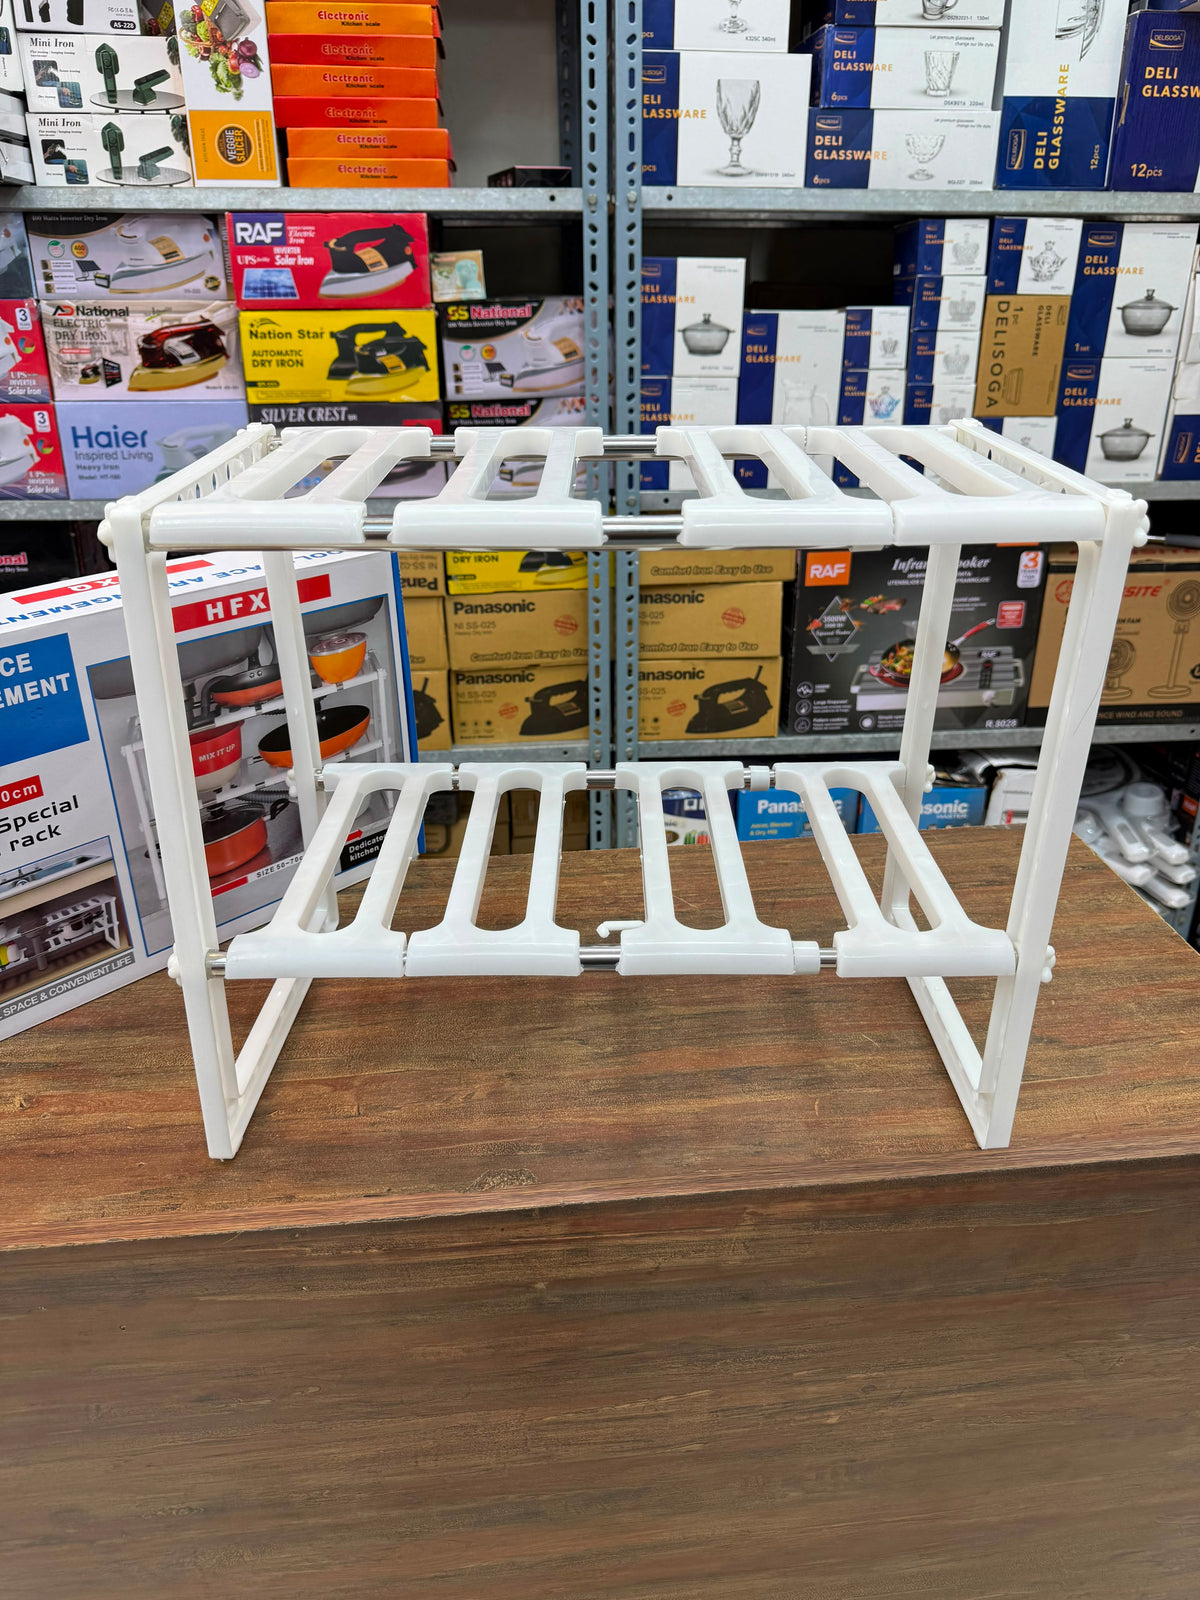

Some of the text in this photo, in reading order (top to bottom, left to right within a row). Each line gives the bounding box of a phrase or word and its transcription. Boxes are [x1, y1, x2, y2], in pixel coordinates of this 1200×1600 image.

[318, 10, 369, 21] Electronic
[30, 38, 74, 48] Mini Iron
[321, 44, 373, 55] Electronic
[834, 50, 856, 60] DELI
[833, 62, 893, 72] GLASSWARE
[1145, 67, 1178, 79] DELI
[322, 73, 373, 83] Electronic
[1142, 85, 1200, 98] GLASSW
[643, 95, 661, 104] ELI
[325, 108, 376, 118] Electronic
[643, 109, 707, 119] LASSWARE
[1048, 64, 1070, 170] GLASSWARE
[38, 118, 81, 127] Mini Iron
[226, 129, 236, 161] VEGGIE
[336, 134, 387, 144] Electronic
[815, 136, 842, 146] DELI
[236, 130, 246, 162] SLICER
[1033, 131, 1048, 169] DELI
[814, 151, 888, 161] GLASSWARE
[1090, 144, 1100, 170] 12pcs
[337, 164, 387, 174] Electronic
[642, 164, 656, 173] pcs
[1130, 163, 1162, 177] 12pcs
[235, 222, 283, 244] RAF
[237, 255, 256, 265] UPS
[275, 255, 296, 265] Solar
[297, 255, 314, 265] Iron
[1085, 255, 1108, 264] DELI
[1084, 267, 1144, 275] GLASSWARE
[19, 309, 28, 321] 3
[76, 305, 129, 317] National
[470, 304, 532, 319] National
[1044, 306, 1052, 325] DELI
[54, 318, 106, 328] ELECTRIC
[55, 331, 107, 340] DRY IRON
[250, 329, 324, 339] Nation Star
[1032, 305, 1044, 357] GLASSWARE
[986, 301, 1010, 408] DELISOGA
[252, 360, 304, 368] DRY IRON
[8, 387, 26, 395] Solar
[1064, 388, 1087, 396] DELI
[1063, 398, 1122, 406] GLASSWARE
[261, 408, 306, 423] SILVER
[308, 408, 347, 422] CREST
[471, 404, 531, 418] National
[37, 412, 46, 424] 3
[71, 425, 148, 448] Haier
[74, 451, 153, 462] Inspired Living
[27, 486, 45, 494] Solar
[0, 552, 28, 566] onal
[452, 556, 471, 564] DRY
[892, 556, 991, 573] Infra ooker
[1023, 551, 1039, 569] 3
[211, 565, 262, 578] ACE
[651, 564, 773, 576] Comfort Iron Easy to Use
[810, 563, 846, 579] RAF
[639, 590, 704, 604] nasonic
[1123, 585, 1162, 597] SITE
[206, 592, 268, 622] HFX
[453, 600, 536, 615] Panasonic
[678, 643, 698, 652] Iron
[700, 642, 724, 652] Easy
[739, 642, 758, 650] Use
[470, 649, 571, 662] Comfort Iron Easy to
[455, 671, 535, 685] Panasonic
[639, 667, 705, 680] anasonic
[199, 744, 235, 763] MIX IT UP
[920, 800, 968, 814] sonic
[0, 795, 80, 834] Special
[10, 824, 61, 852] rack
[349, 835, 386, 853] Dedicate
[350, 846, 379, 861] kitchen
[256, 856, 303, 878] SIZE 50-70c
[3, 956, 132, 1016] SPACE & CONVENIENT LIFE
